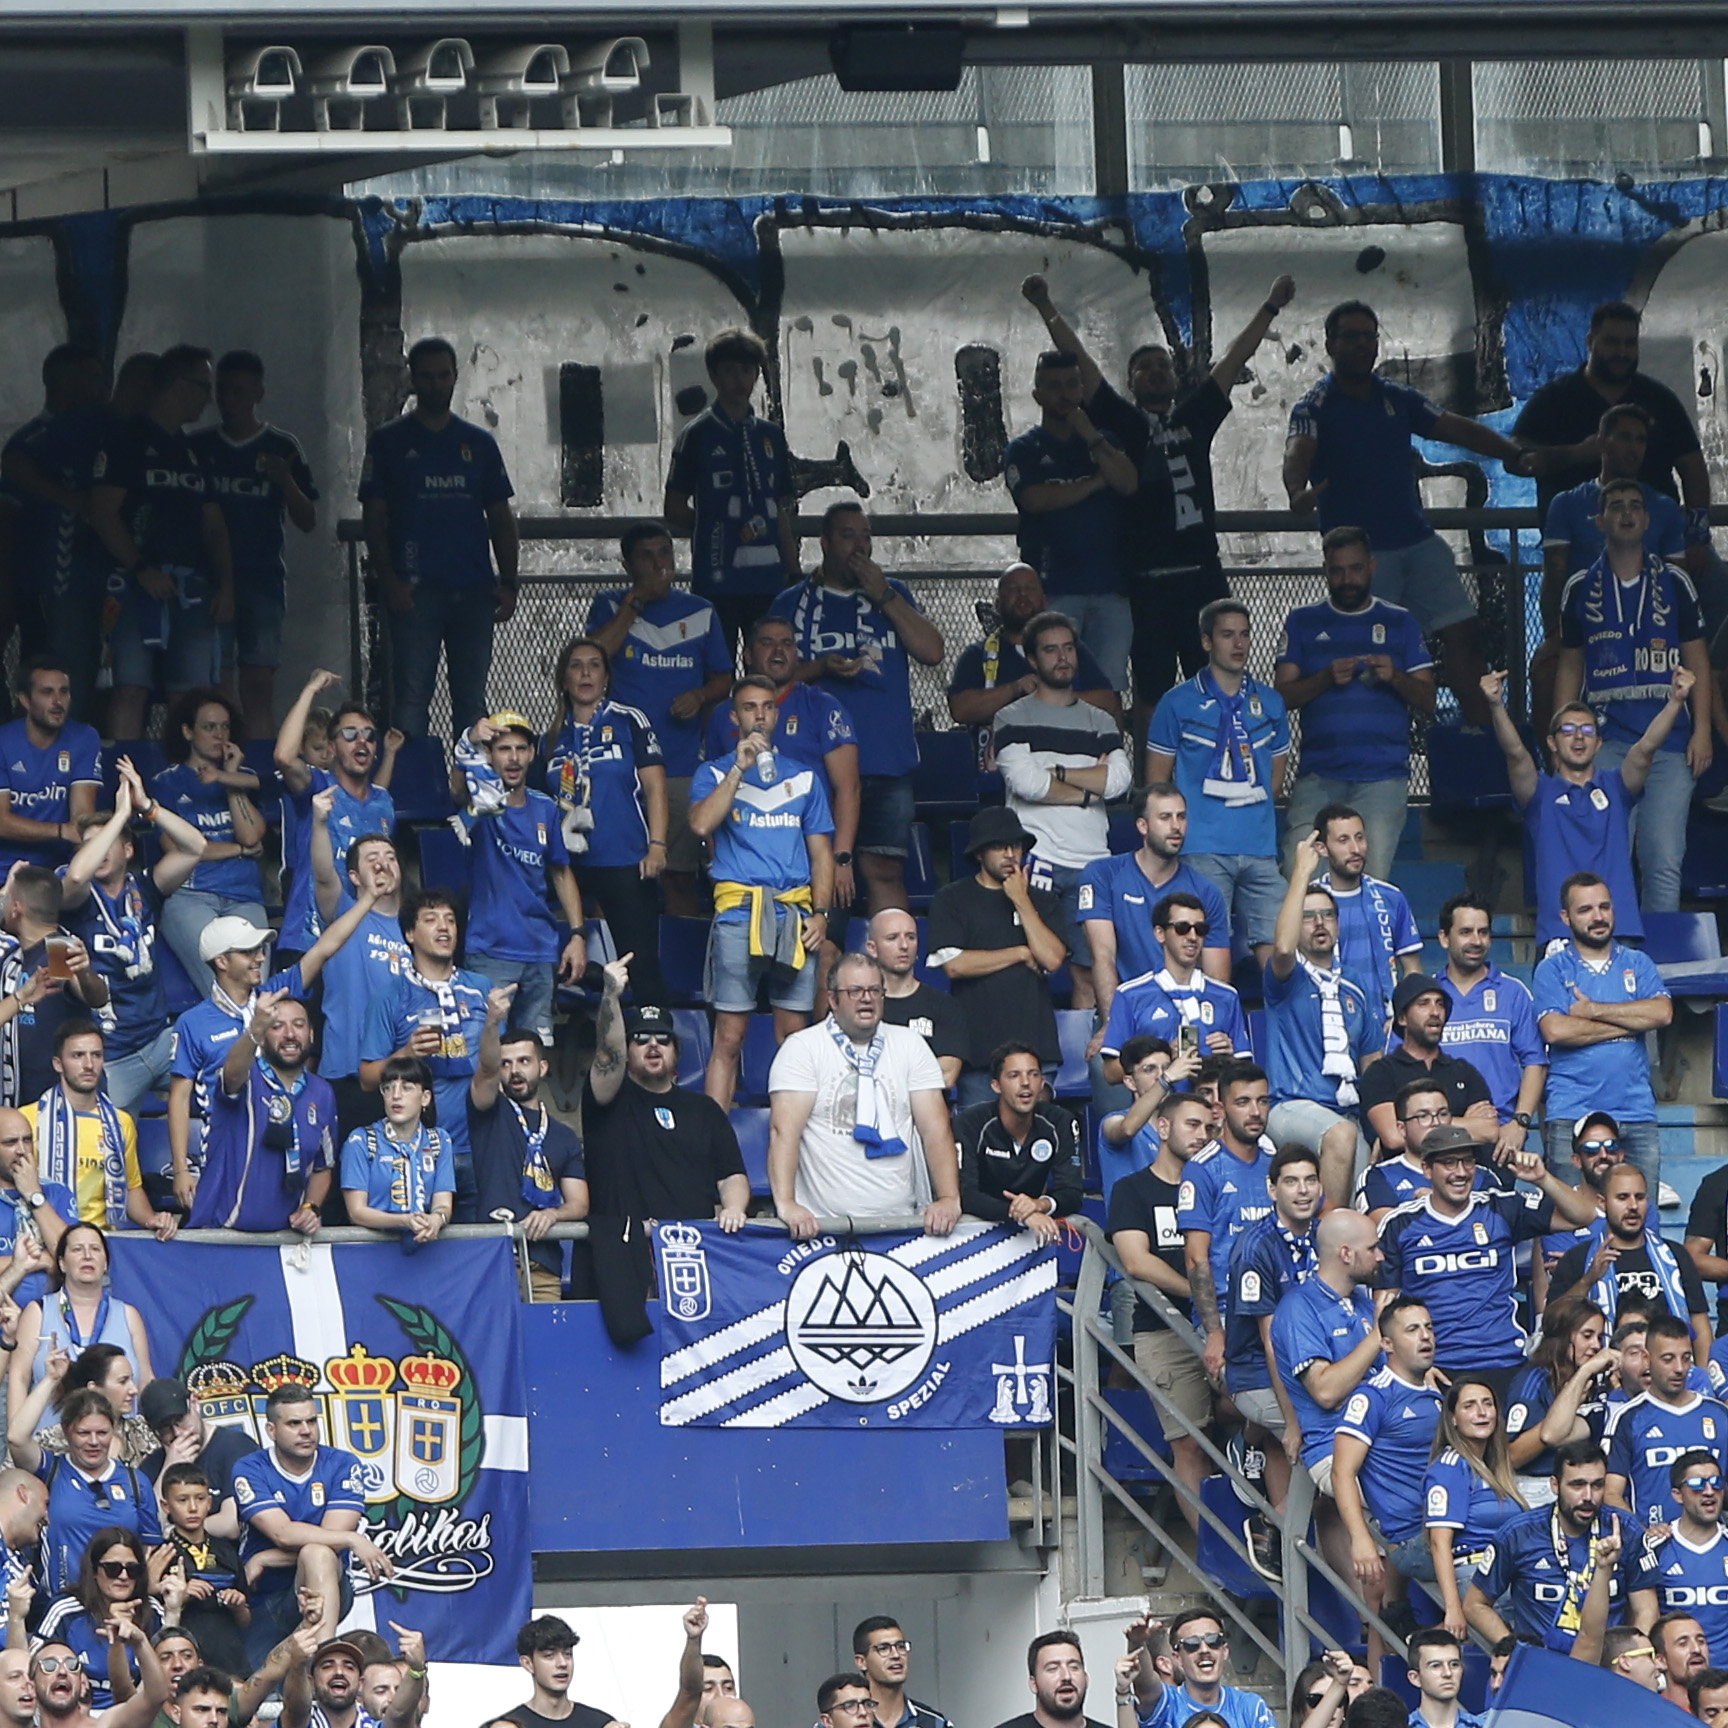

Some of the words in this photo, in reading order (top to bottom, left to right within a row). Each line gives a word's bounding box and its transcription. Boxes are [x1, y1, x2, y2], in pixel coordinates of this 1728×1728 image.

[424, 475, 467, 491] NMR
[640, 651, 695, 669] Asturias
[749, 812, 802, 831] Asturias
[1442, 1027, 1508, 1044] TURIANA
[777, 1236, 836, 1277] OVIEDO
[1415, 1250, 1499, 1276] DIGI
[886, 1360, 952, 1420] SPEZIAL
[202, 1400, 245, 1415] OFC
[417, 1398, 439, 1410] RO
